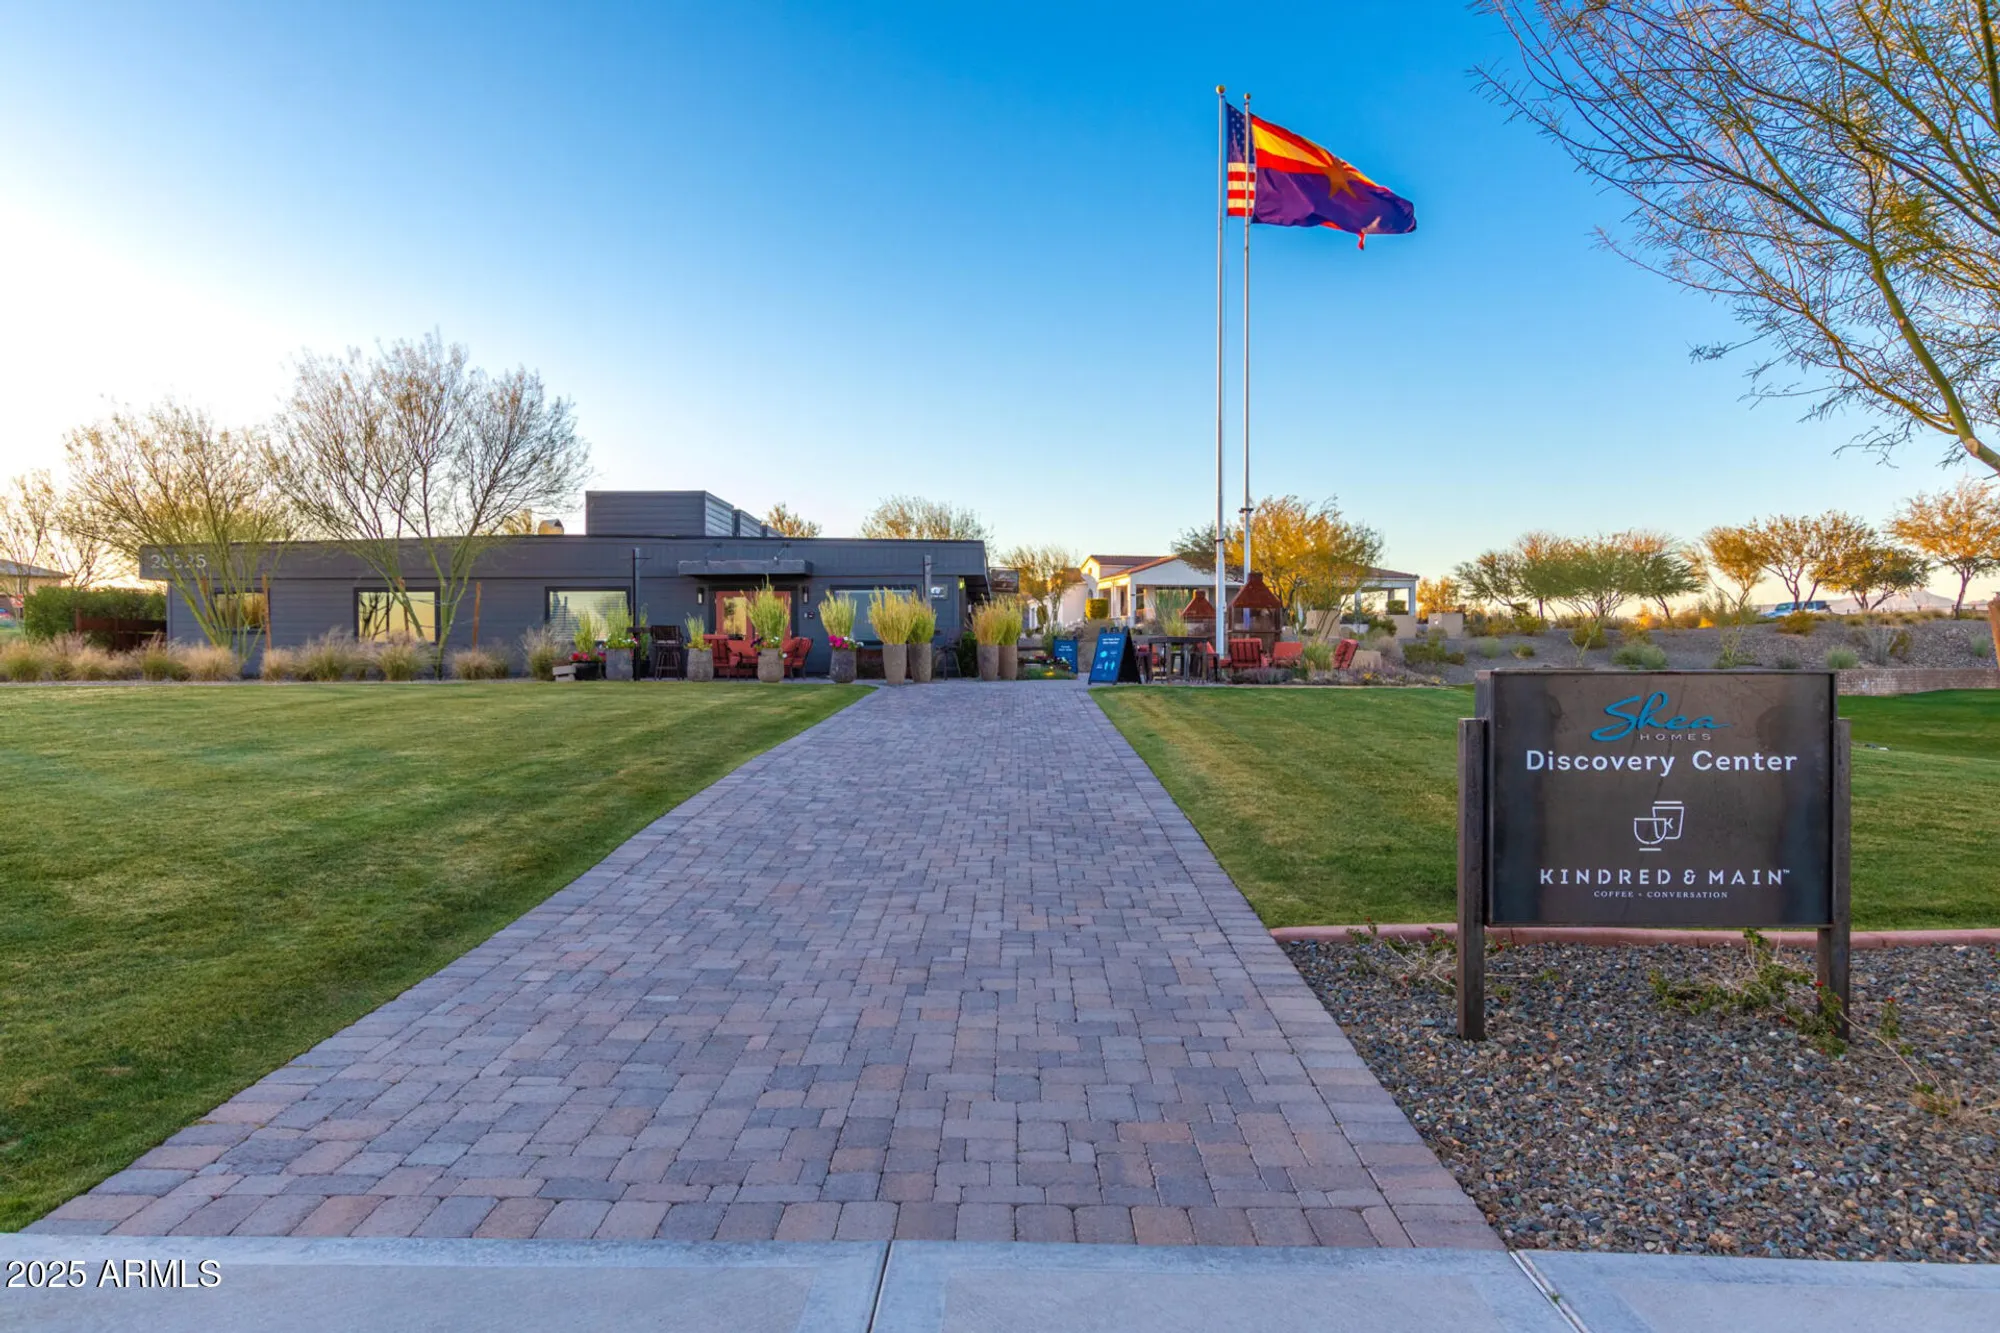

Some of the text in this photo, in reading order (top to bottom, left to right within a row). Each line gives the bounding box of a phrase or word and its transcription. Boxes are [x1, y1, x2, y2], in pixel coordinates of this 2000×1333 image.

[1591, 691, 1733, 741] Shea
[1640, 733, 1712, 741] HOMES
[1526, 750, 1798, 777] Discovery Center
[1540, 869, 1671, 885] KINDRED
[1683, 869, 1696, 885] &
[1593, 890, 1634, 898] COFFEE
[1646, 890, 1728, 898] CONVERSATION
